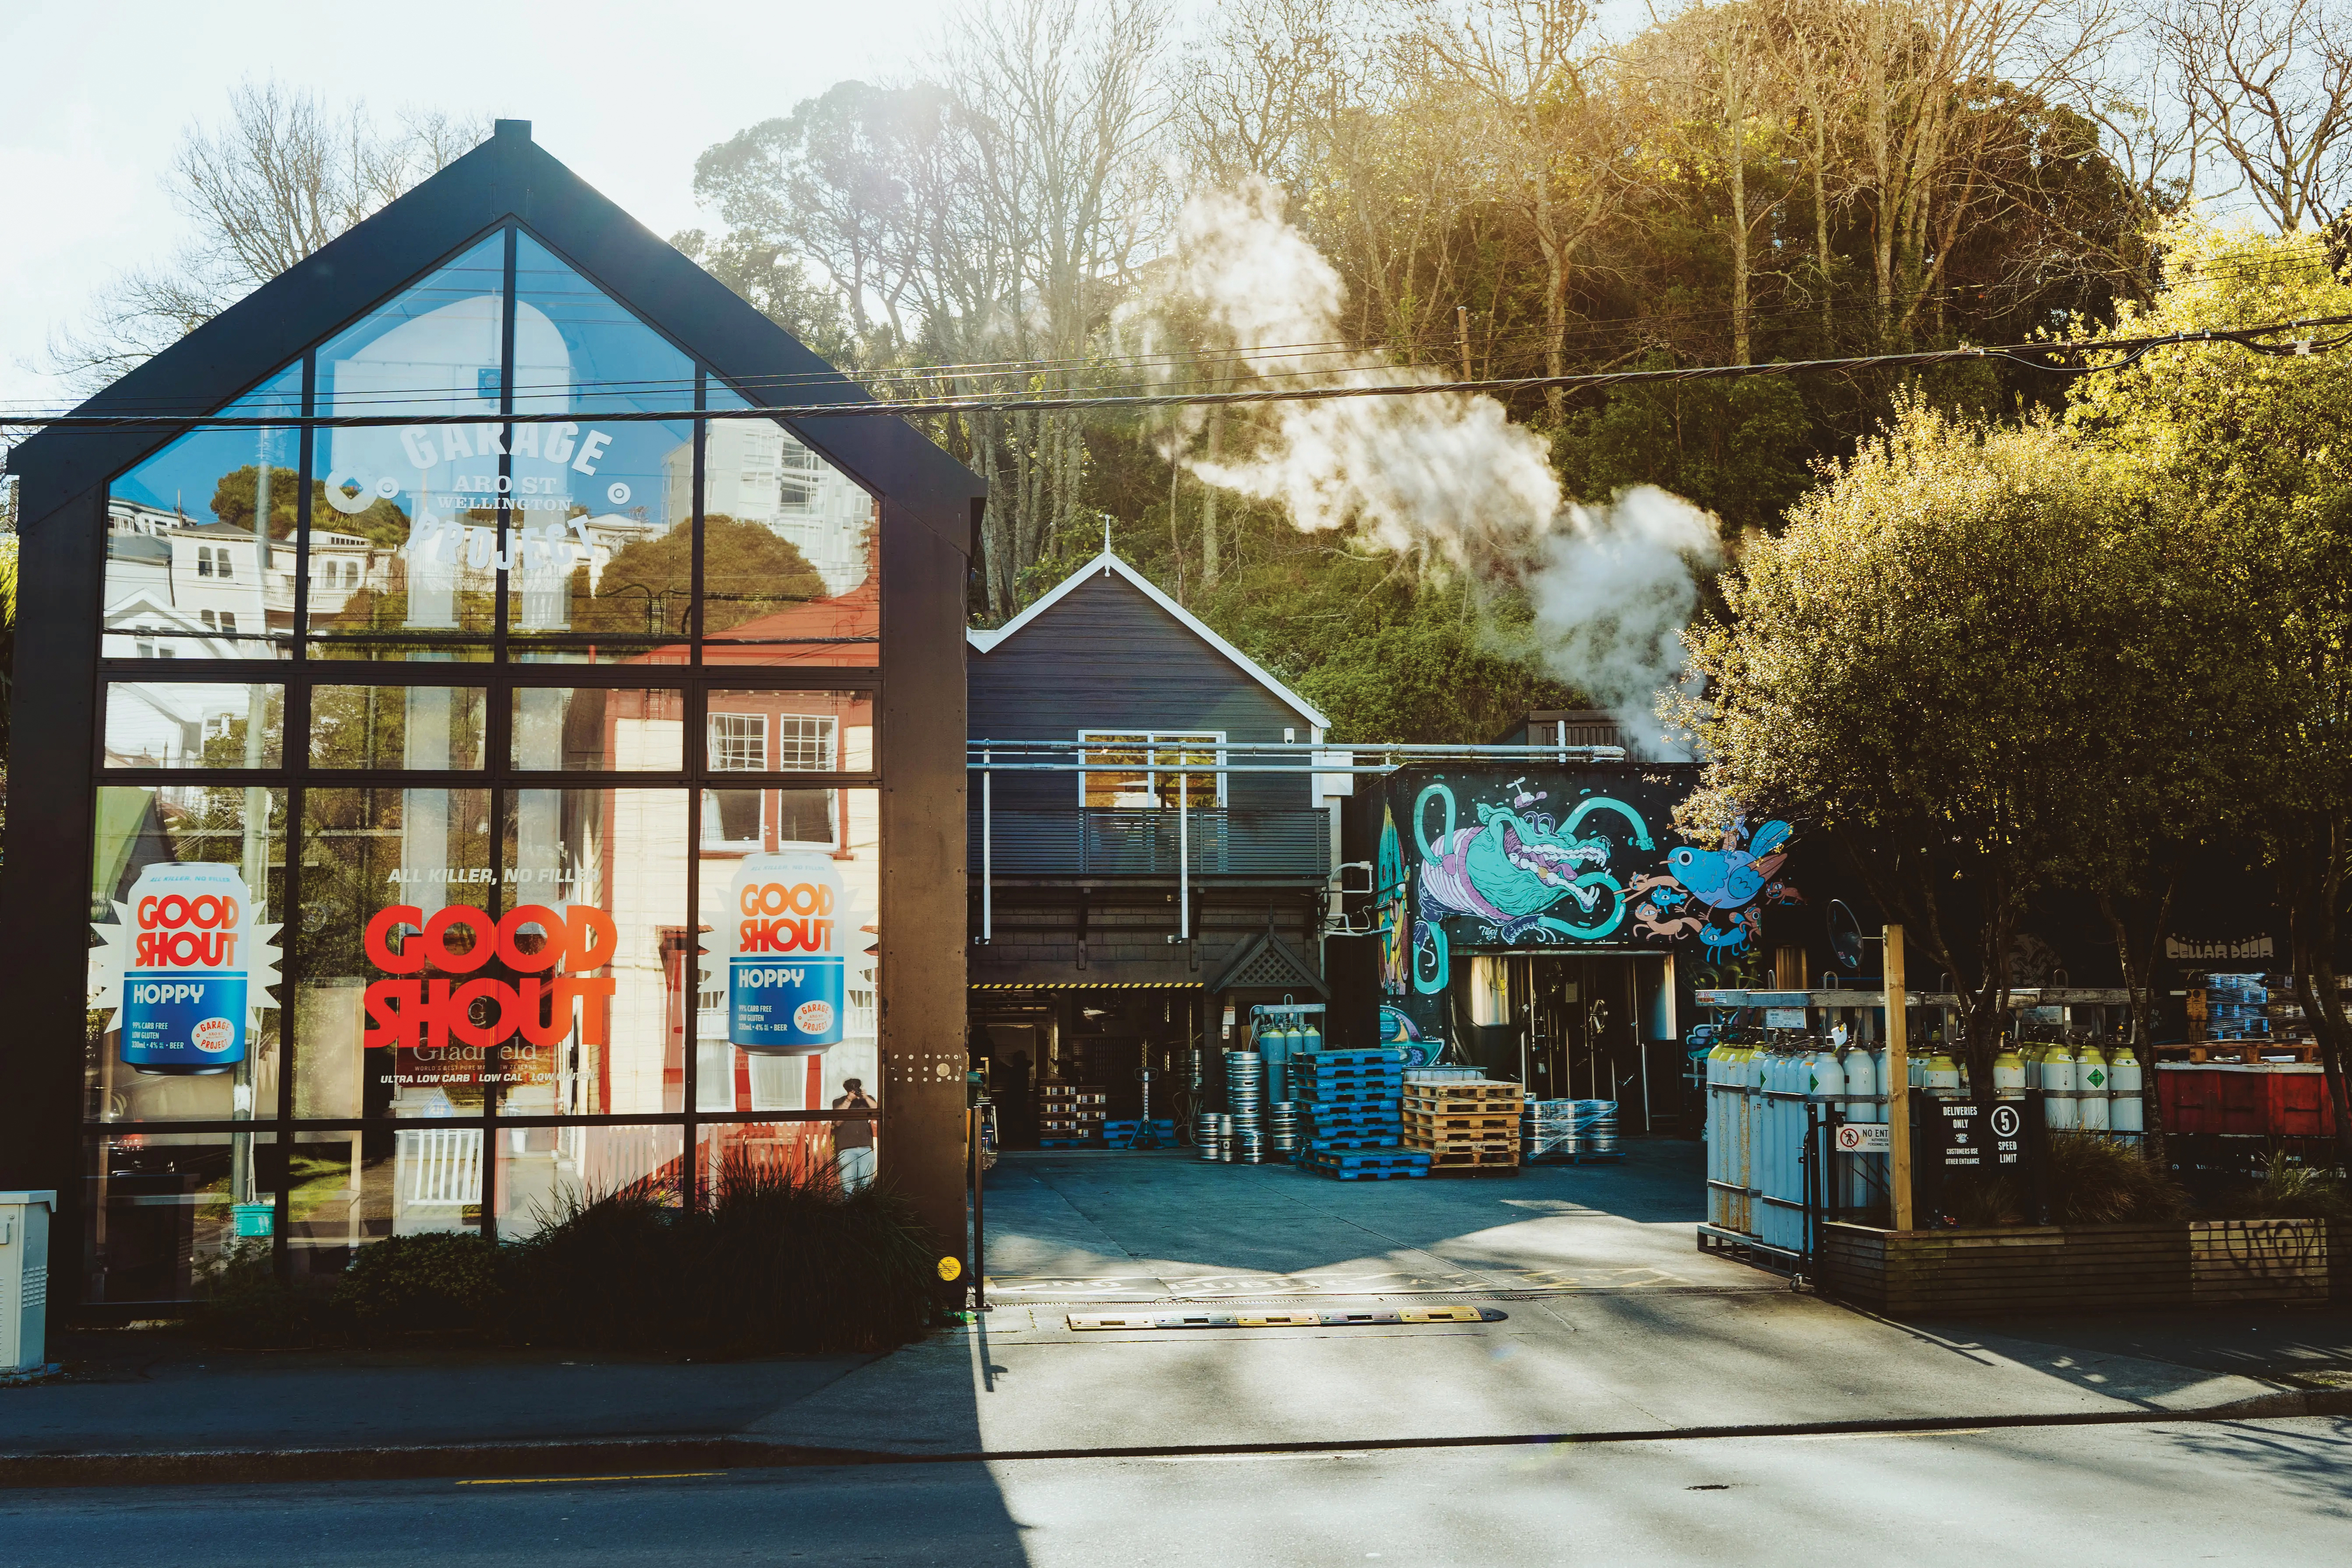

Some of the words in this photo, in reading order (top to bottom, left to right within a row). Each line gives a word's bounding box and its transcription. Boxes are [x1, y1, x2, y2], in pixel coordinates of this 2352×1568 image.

[400, 421, 612, 476] GARAGE
[453, 475, 512, 494] ARO
[522, 477, 557, 494] ST
[438, 497, 572, 511] WELLINGTON
[405, 511, 595, 570] PROJECT
[387, 869, 421, 883] ALL
[428, 868, 497, 885] KILLER,
[504, 869, 533, 883] NO
[538, 868, 599, 883] FILLER
[740, 883, 834, 917] GOOD
[138, 894, 240, 930] GOOD
[364, 904, 618, 974] GOOD
[740, 918, 834, 952] SHOUT
[136, 932, 238, 967] SHOUT
[2166, 937, 2227, 958] CELLAR
[2231, 937, 2274, 958] DOOR
[739, 969, 804, 988] HOPPY
[134, 984, 204, 1004] HOPPY
[364, 978, 615, 1048] SHOUT
[802, 1004, 829, 1014] GARAGE
[200, 1021, 230, 1032] GARAGE
[802, 1021, 828, 1031] PROJECT
[201, 1038, 228, 1049] PROJECT
[413, 1036, 539, 1061] Gladeld
[381, 1075, 413, 1083] ULTRA
[417, 1074, 440, 1083] LOW
[442, 1074, 470, 1082] CARB
[479, 1074, 502, 1082] LOW
[504, 1074, 523, 1082] CAL
[531, 1072, 555, 1081] LOW
[556, 1071, 595, 1081] GLUTEN
[1943, 1107, 1978, 1116] DELIVERIES
[1953, 1119, 1968, 1128] ONLY
[2001, 1112, 2009, 1131] 5
[1998, 1141, 2017, 1150] SPEED
[2000, 1154, 2017, 1163] LIMIT
[1166, 1280, 1357, 1289] PUBLIC
[1410, 1275, 1614, 1285] AESS
